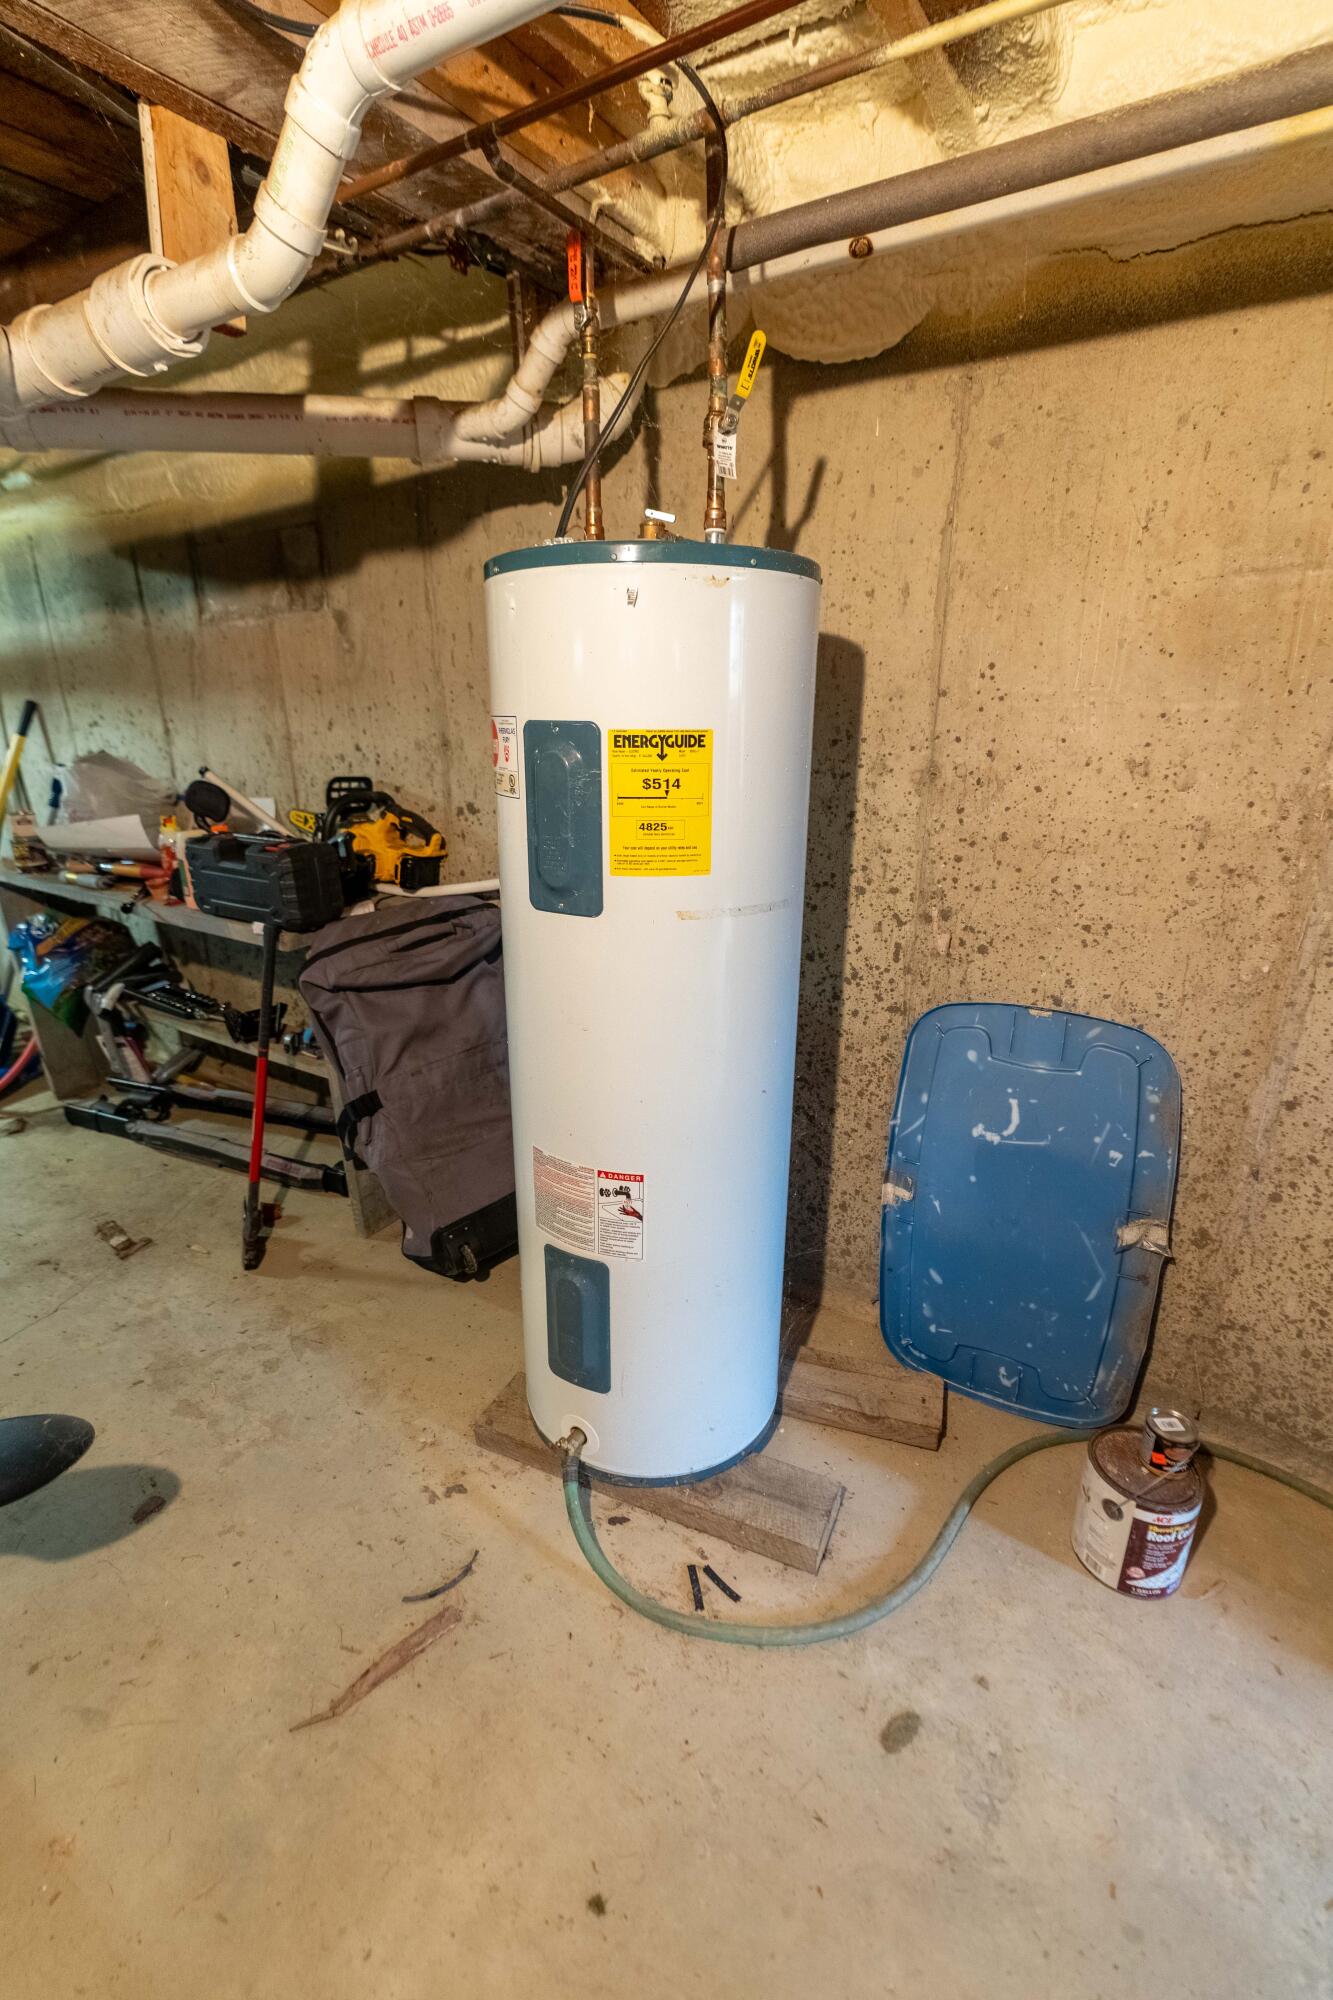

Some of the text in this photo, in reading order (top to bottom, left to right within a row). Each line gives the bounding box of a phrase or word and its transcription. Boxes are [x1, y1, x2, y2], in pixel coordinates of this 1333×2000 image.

[408, 14, 429, 38] ASTM
[613, 734, 706, 750] ENERGYGUIDE
[642, 778, 681, 790] $514
[639, 822, 667, 831] 4825
[608, 1172, 641, 1181] DANGER
[1146, 1530, 1177, 1542] Roof
